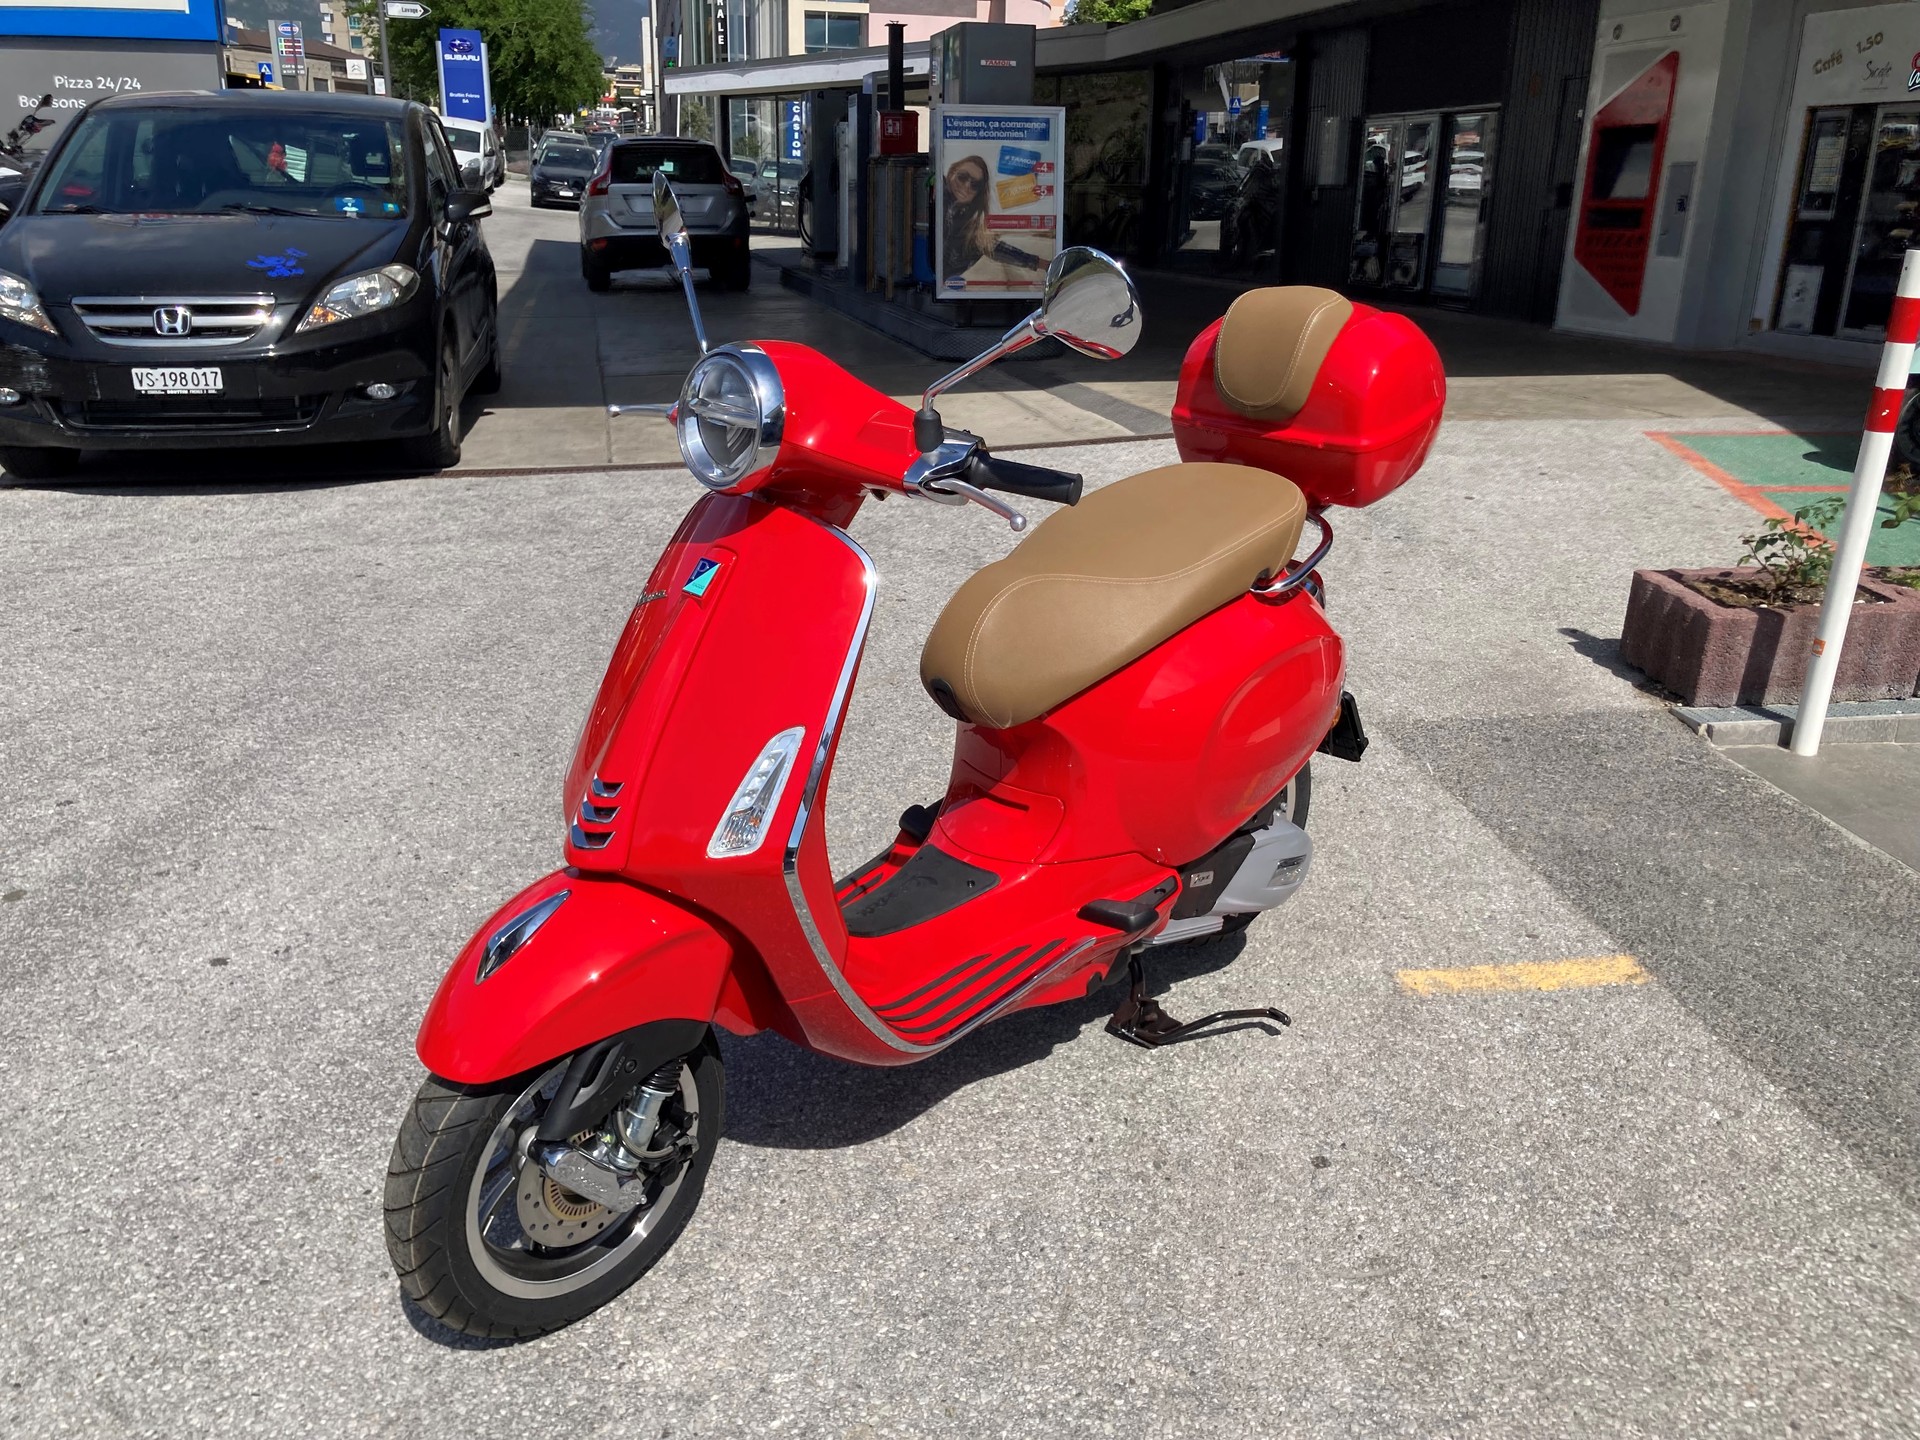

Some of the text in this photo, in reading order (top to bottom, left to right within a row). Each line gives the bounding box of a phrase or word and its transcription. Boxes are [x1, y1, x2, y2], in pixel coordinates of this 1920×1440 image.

[1812, 49, 1843, 75] Café
[1856, 31, 1884, 54] 1.50
[54, 75, 142, 92] Pizza 24/24
[18, 94, 87, 109] Boisons
[792, 101, 801, 157] CASION
[946, 118, 1047, 130] L'évasion, ça commence
[946, 129, 960, 137] par
[962, 128, 978, 137] des
